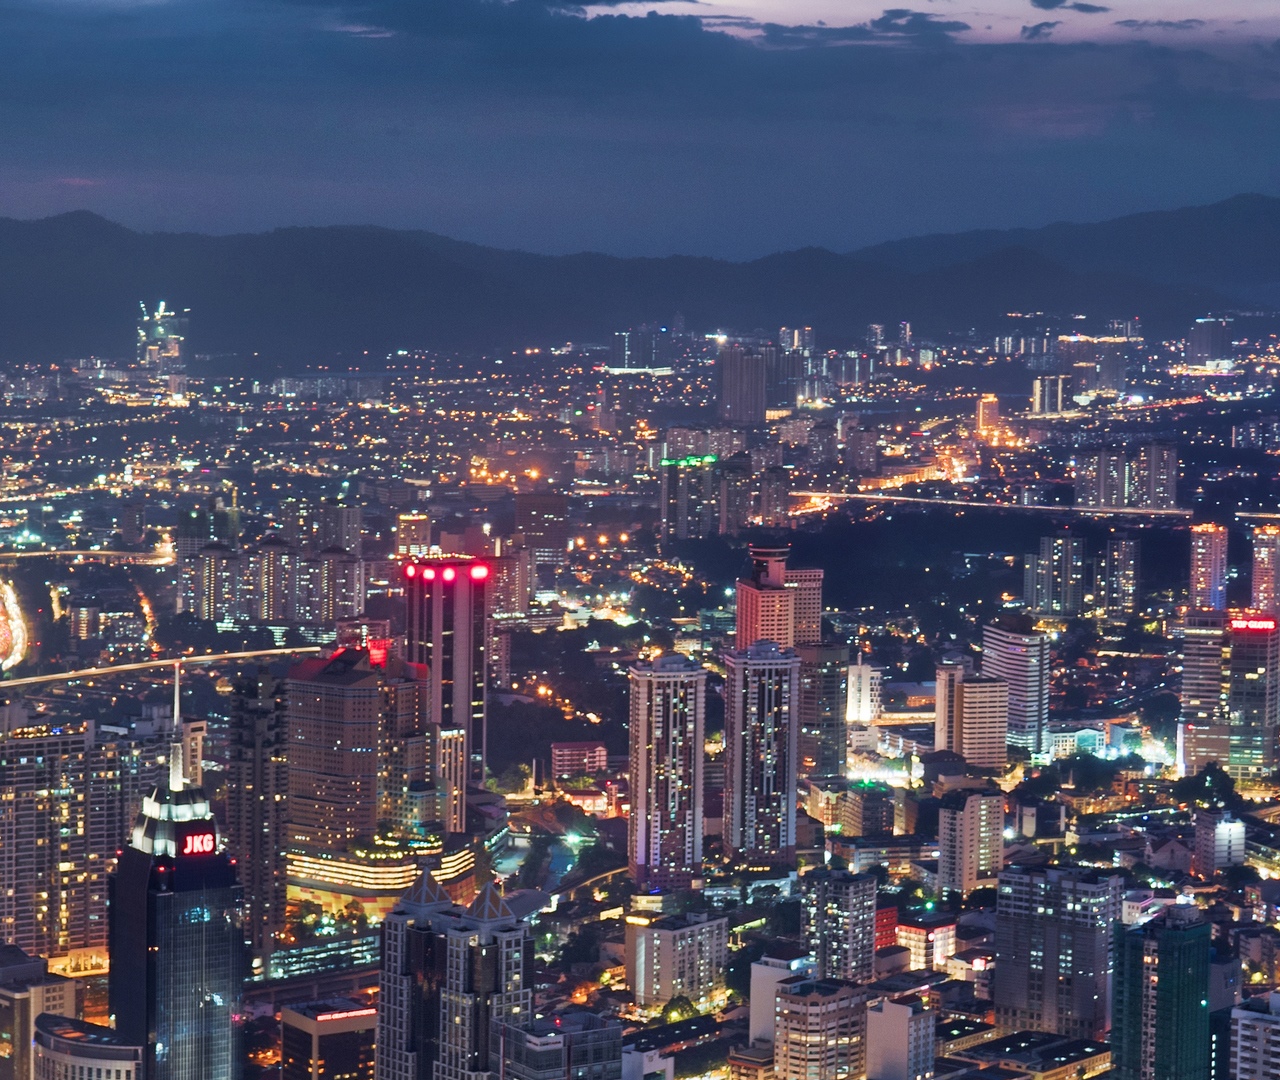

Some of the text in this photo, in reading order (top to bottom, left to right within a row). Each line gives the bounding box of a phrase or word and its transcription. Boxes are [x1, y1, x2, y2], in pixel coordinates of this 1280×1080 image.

[1231, 620, 1275, 629] TOP GLOVE
[184, 833, 214, 854] JKG
